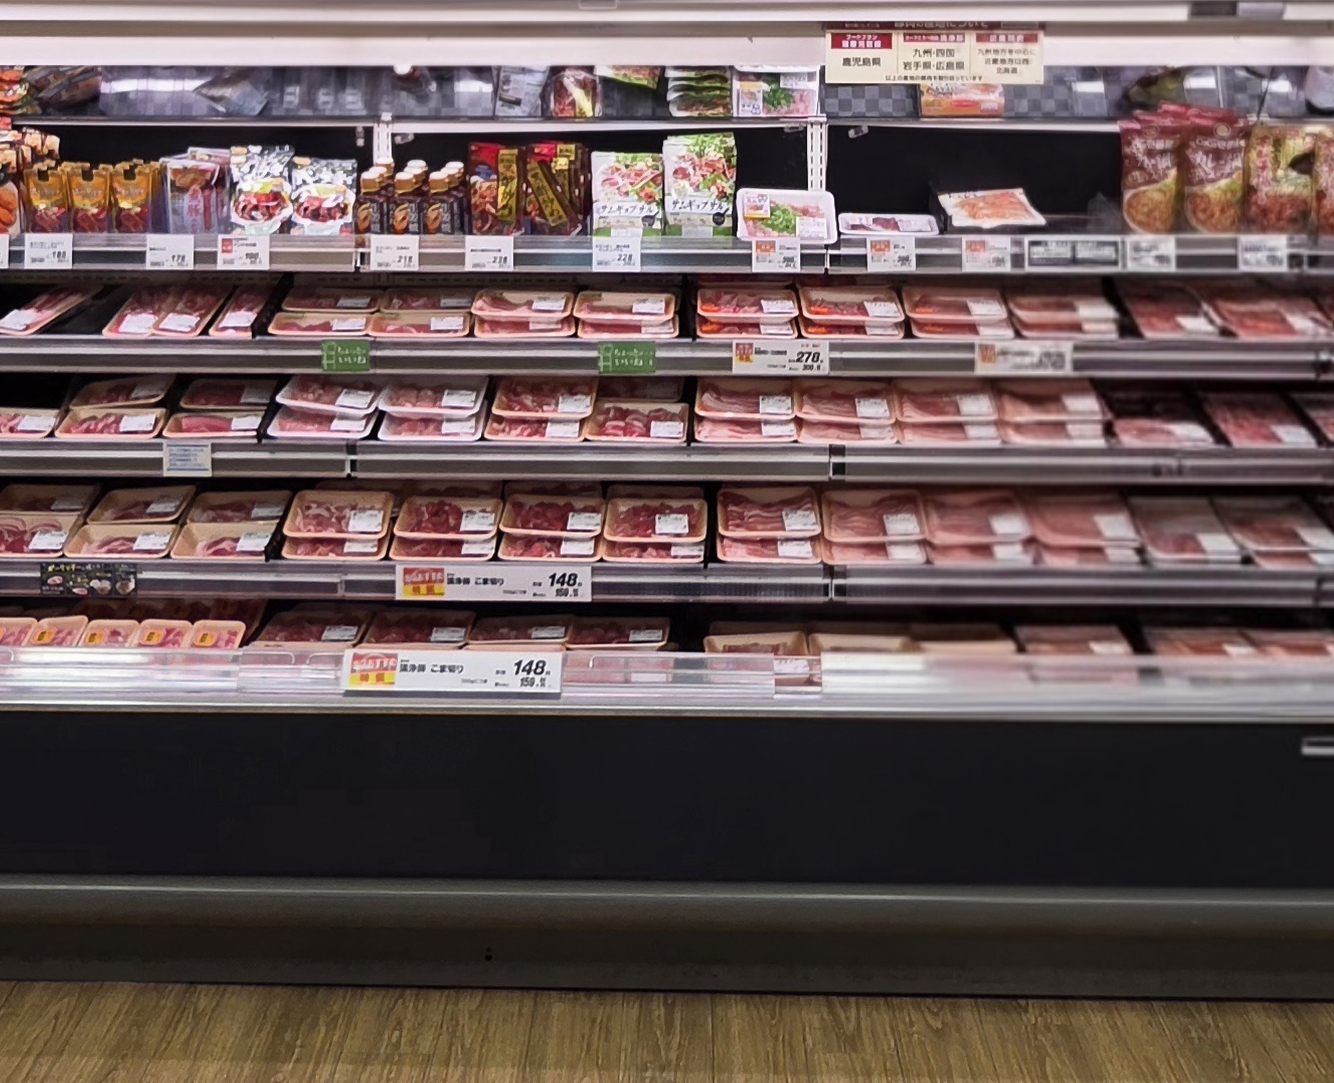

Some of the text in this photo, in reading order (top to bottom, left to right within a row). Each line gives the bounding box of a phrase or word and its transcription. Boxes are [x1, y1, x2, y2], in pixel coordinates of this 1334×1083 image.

[976, 47, 1037, 57] 九州地方を中心に
[841, 56, 882, 67] 鹿児島県
[995, 66, 1019, 75] 北海道
[396, 254, 413, 264] 218
[795, 350, 820, 363] 278
[548, 572, 579, 587] 148
[513, 659, 547, 676] 148
